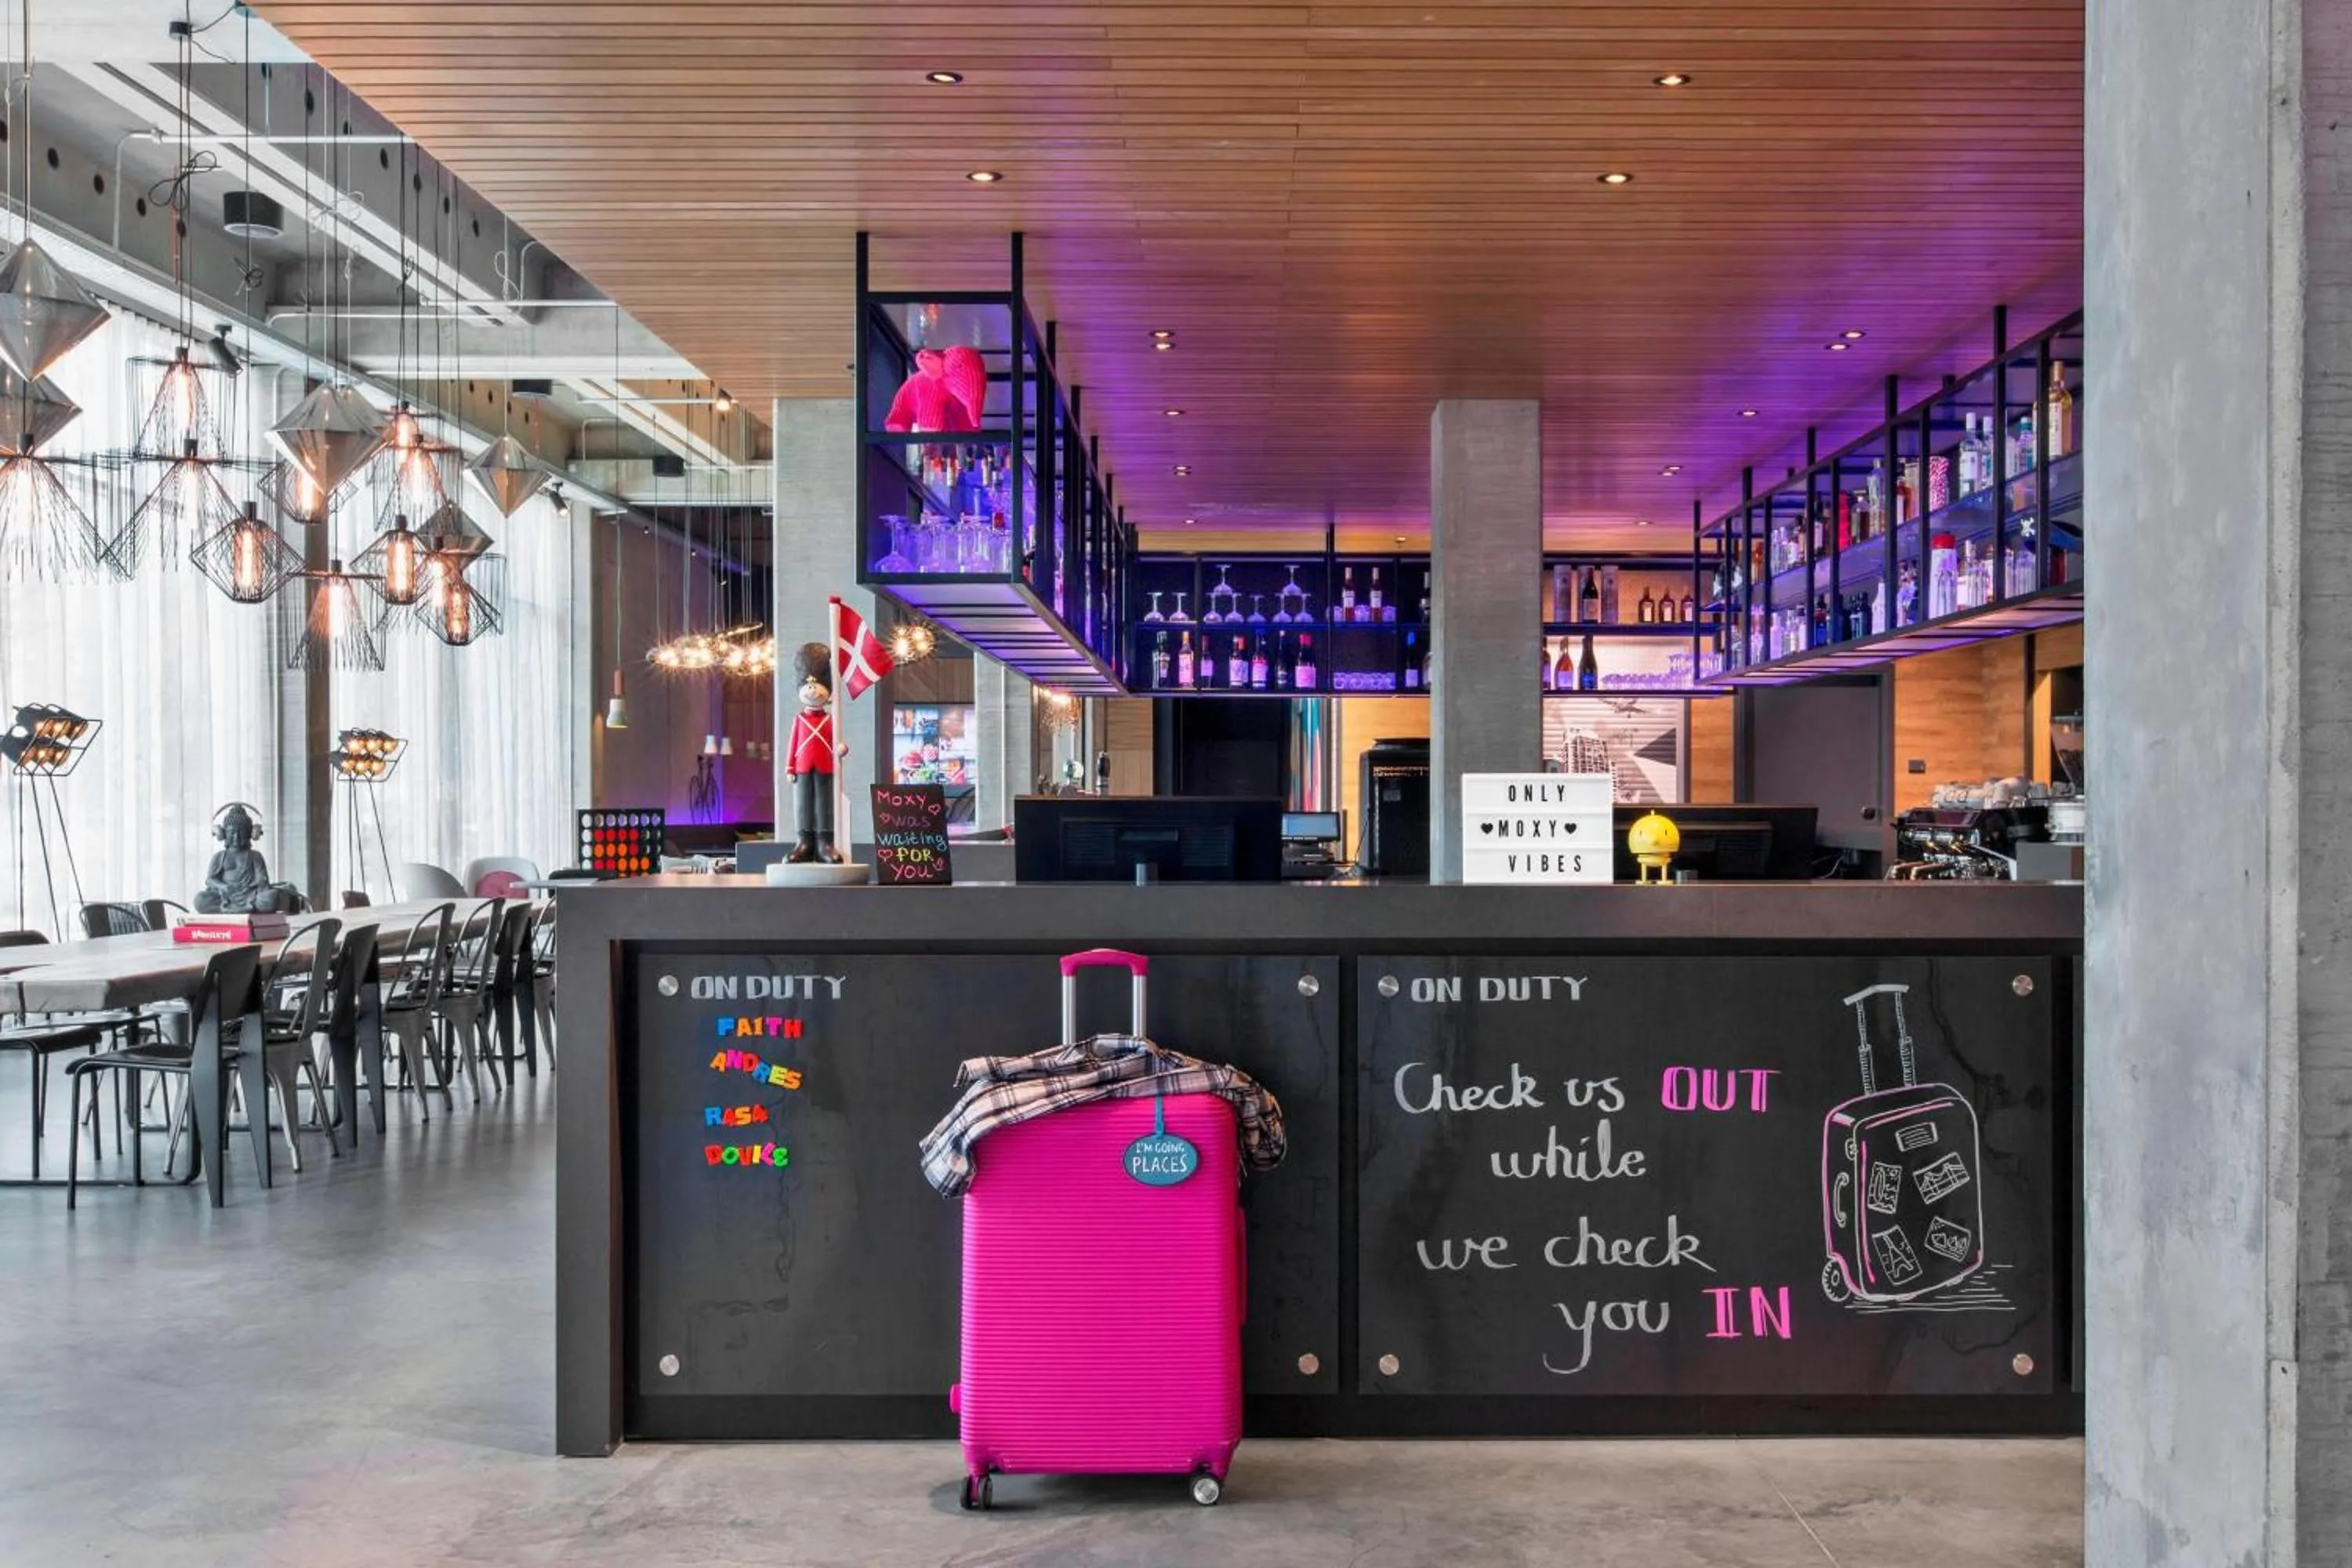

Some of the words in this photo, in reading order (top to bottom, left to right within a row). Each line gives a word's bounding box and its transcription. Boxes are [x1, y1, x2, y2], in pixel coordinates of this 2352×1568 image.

[1508, 784, 1565, 802] ONLY
[892, 815, 931, 828] was
[1498, 820, 1557, 837] MOXY
[877, 831, 947, 851] waiting
[1508, 855, 1581, 873] VIBES
[691, 976, 737, 1000] ON
[746, 975, 846, 1000] DUTY
[1411, 978, 1461, 1002] ON
[1479, 975, 1588, 1001] DUTY
[717, 1016, 803, 1039] FAITH
[710, 1049, 802, 1090] ANDRES
[1393, 1062, 1545, 1113] Check
[1563, 1076, 1625, 1112] us
[1661, 1065, 1782, 1112] OUT
[705, 1104, 768, 1126] RASA
[1136, 1142, 1152, 1153] I'M
[1490, 1118, 1647, 1182] while
[1132, 1153, 1188, 1174] PLACES
[1416, 1236, 1518, 1270] we
[1543, 1214, 1717, 1272] check
[1542, 1300, 1670, 1374] you
[1701, 1287, 1792, 1339] IN
